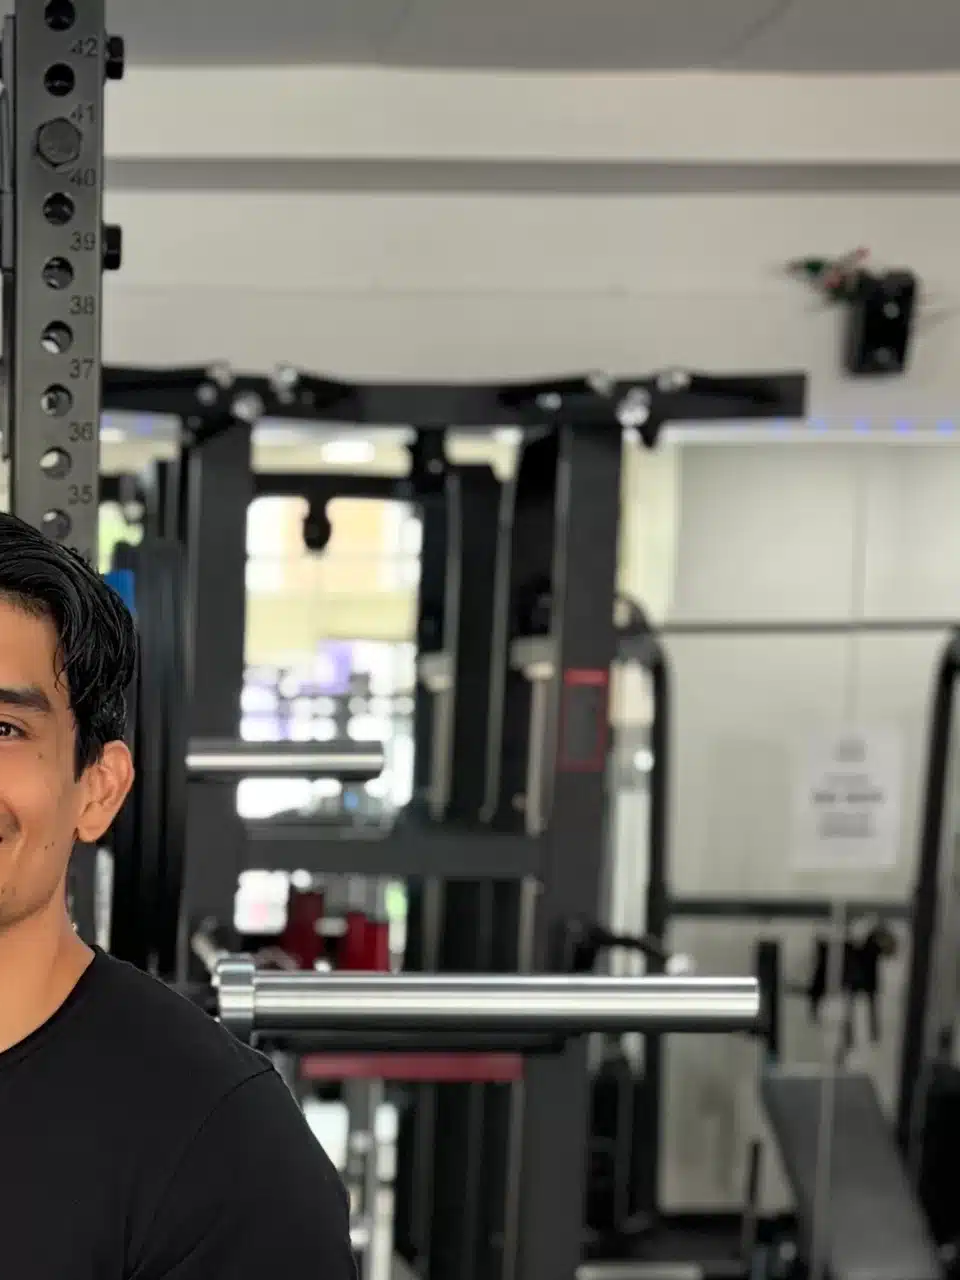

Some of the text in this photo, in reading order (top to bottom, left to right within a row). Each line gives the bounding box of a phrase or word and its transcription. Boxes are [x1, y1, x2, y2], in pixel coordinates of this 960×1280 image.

[69, 37, 98, 57] 42
[69, 104, 96, 124] 41
[69, 168, 96, 188] 40
[69, 231, 96, 252] 39
[69, 295, 95, 316] 38
[69, 358, 95, 380] 37
[68, 421, 94, 443] 36
[67, 484, 93, 505] 35
